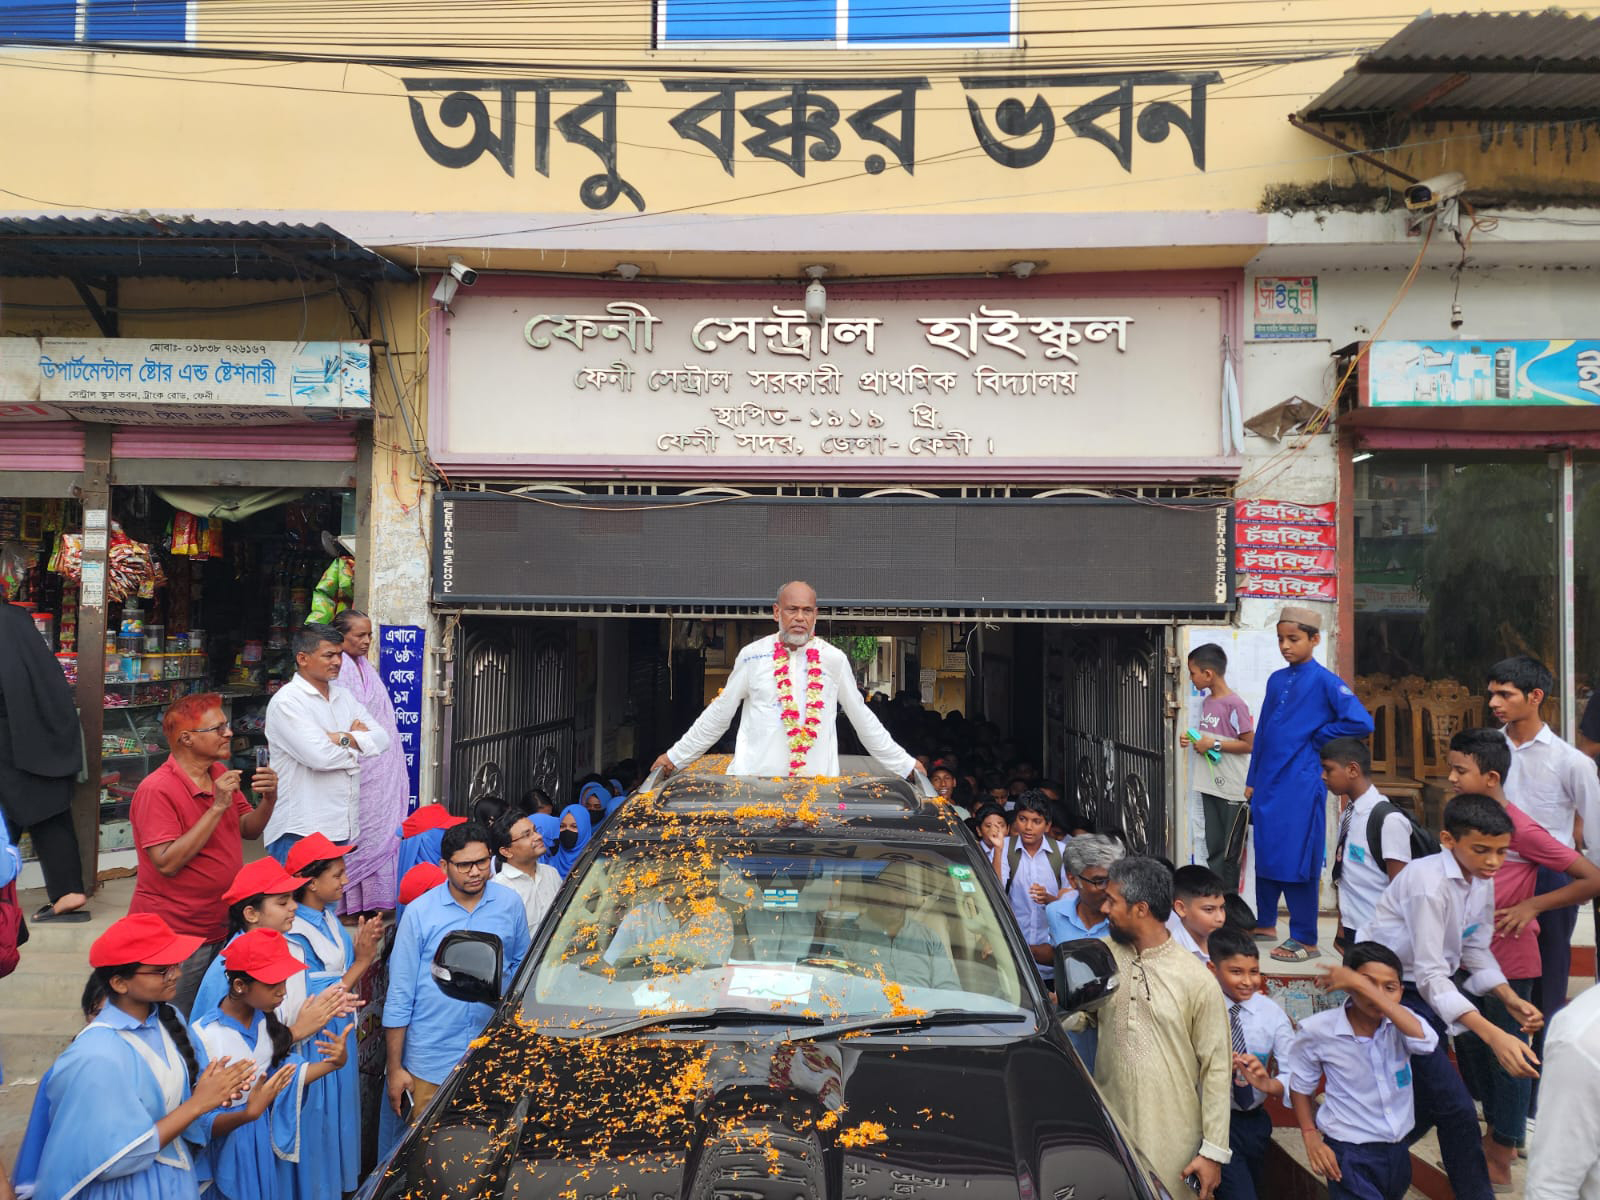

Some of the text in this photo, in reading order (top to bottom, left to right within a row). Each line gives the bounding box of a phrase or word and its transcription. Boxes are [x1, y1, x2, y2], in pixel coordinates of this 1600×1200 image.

[401, 71, 1224, 212] আবু বক্কর ভবন
[524, 302, 1135, 364] ফেনী সেন্ট্রাল হাইস্কুল
[139, 358, 173, 383] ষ্টোর
[574, 360, 1079, 396] ফেনী সেন্ট্রাল সরকারী প্রাথমিক বিদ্যালয়
[809, 408, 885, 428] ১৯১৯
[656, 427, 719, 452] ফেনী
[734, 431, 804, 454] সদর,
[909, 430, 971, 454] ফেনী
[443, 507, 454, 549] CENTRAL
[443, 555, 454, 593] SCHOOL
[385, 629, 417, 643] এখানে
[389, 669, 415, 684] থেকে
[393, 691, 410, 704] ৯ম
